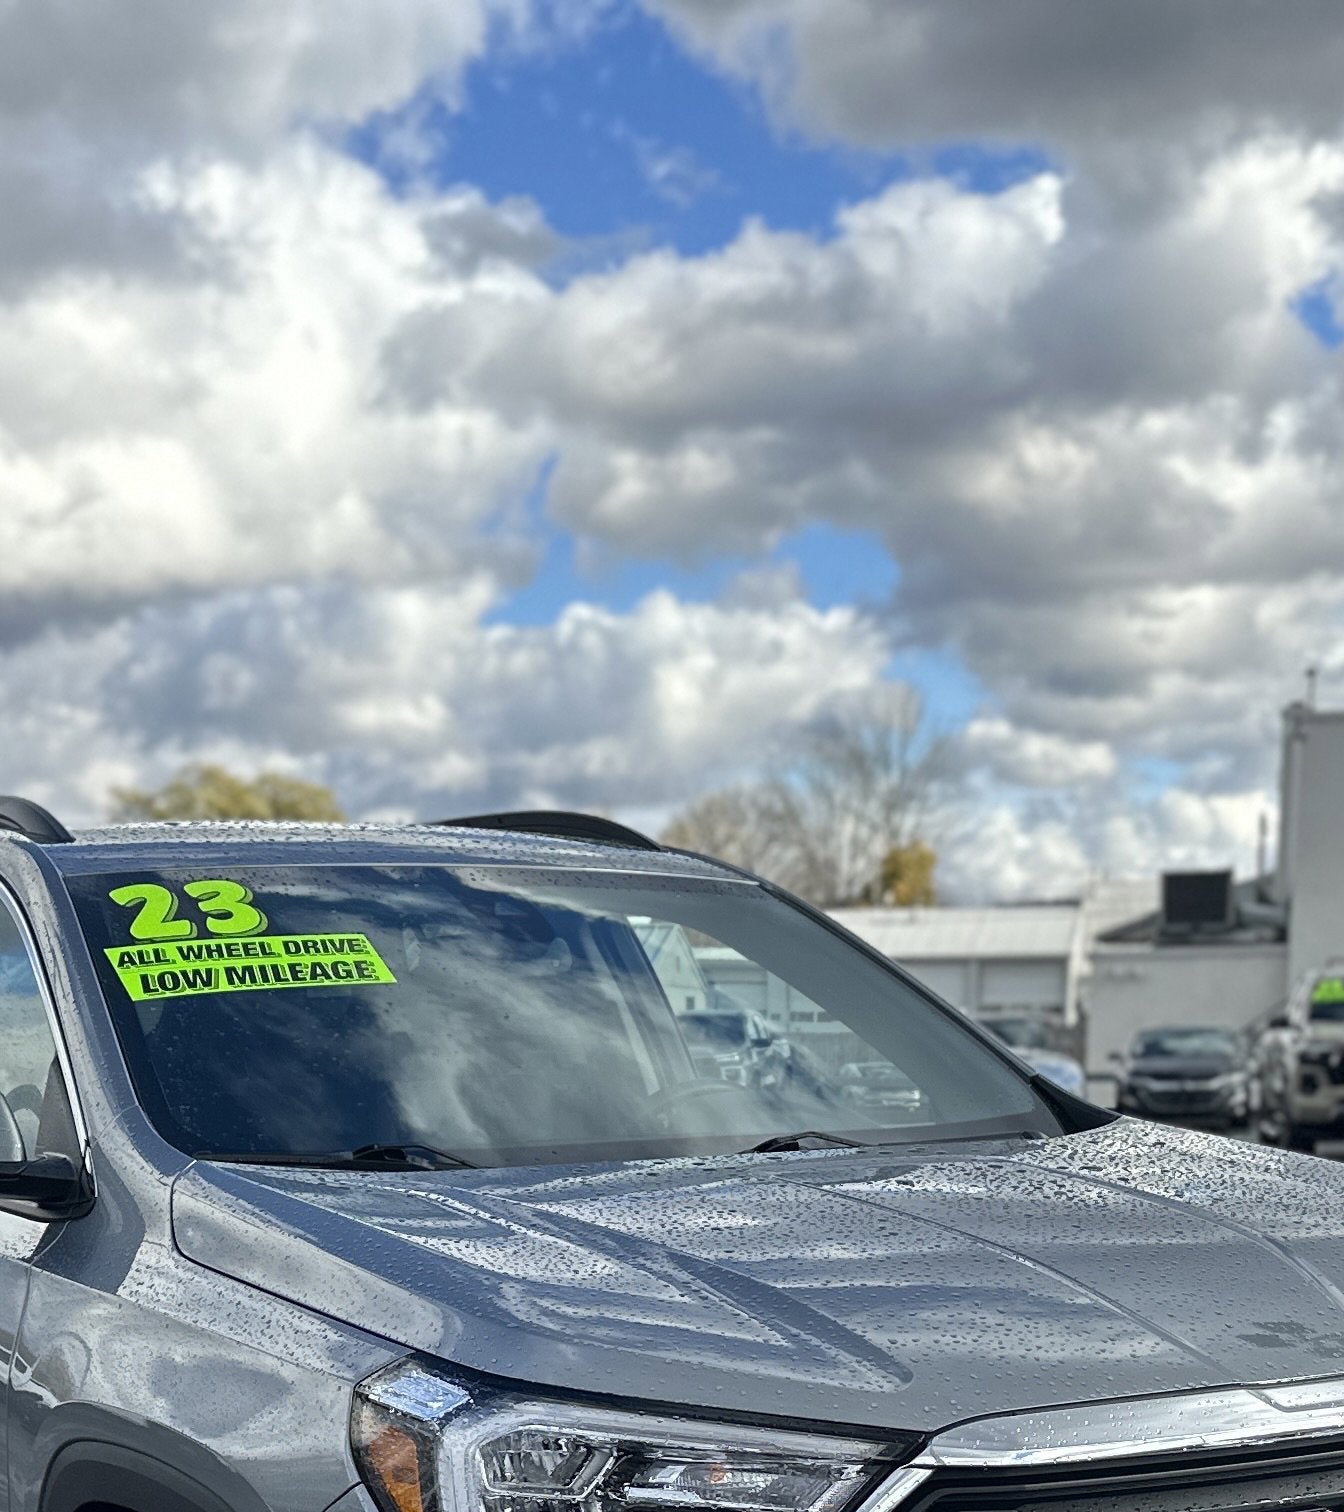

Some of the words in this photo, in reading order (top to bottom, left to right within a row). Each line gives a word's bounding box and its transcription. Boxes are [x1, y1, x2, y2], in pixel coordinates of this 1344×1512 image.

[108, 879, 267, 940] 23
[117, 946, 175, 969] ALL
[176, 940, 280, 963] WHEEL
[283, 937, 369, 958] DRIVE
[139, 967, 218, 996] LOW
[224, 958, 380, 987] MILEAGE
